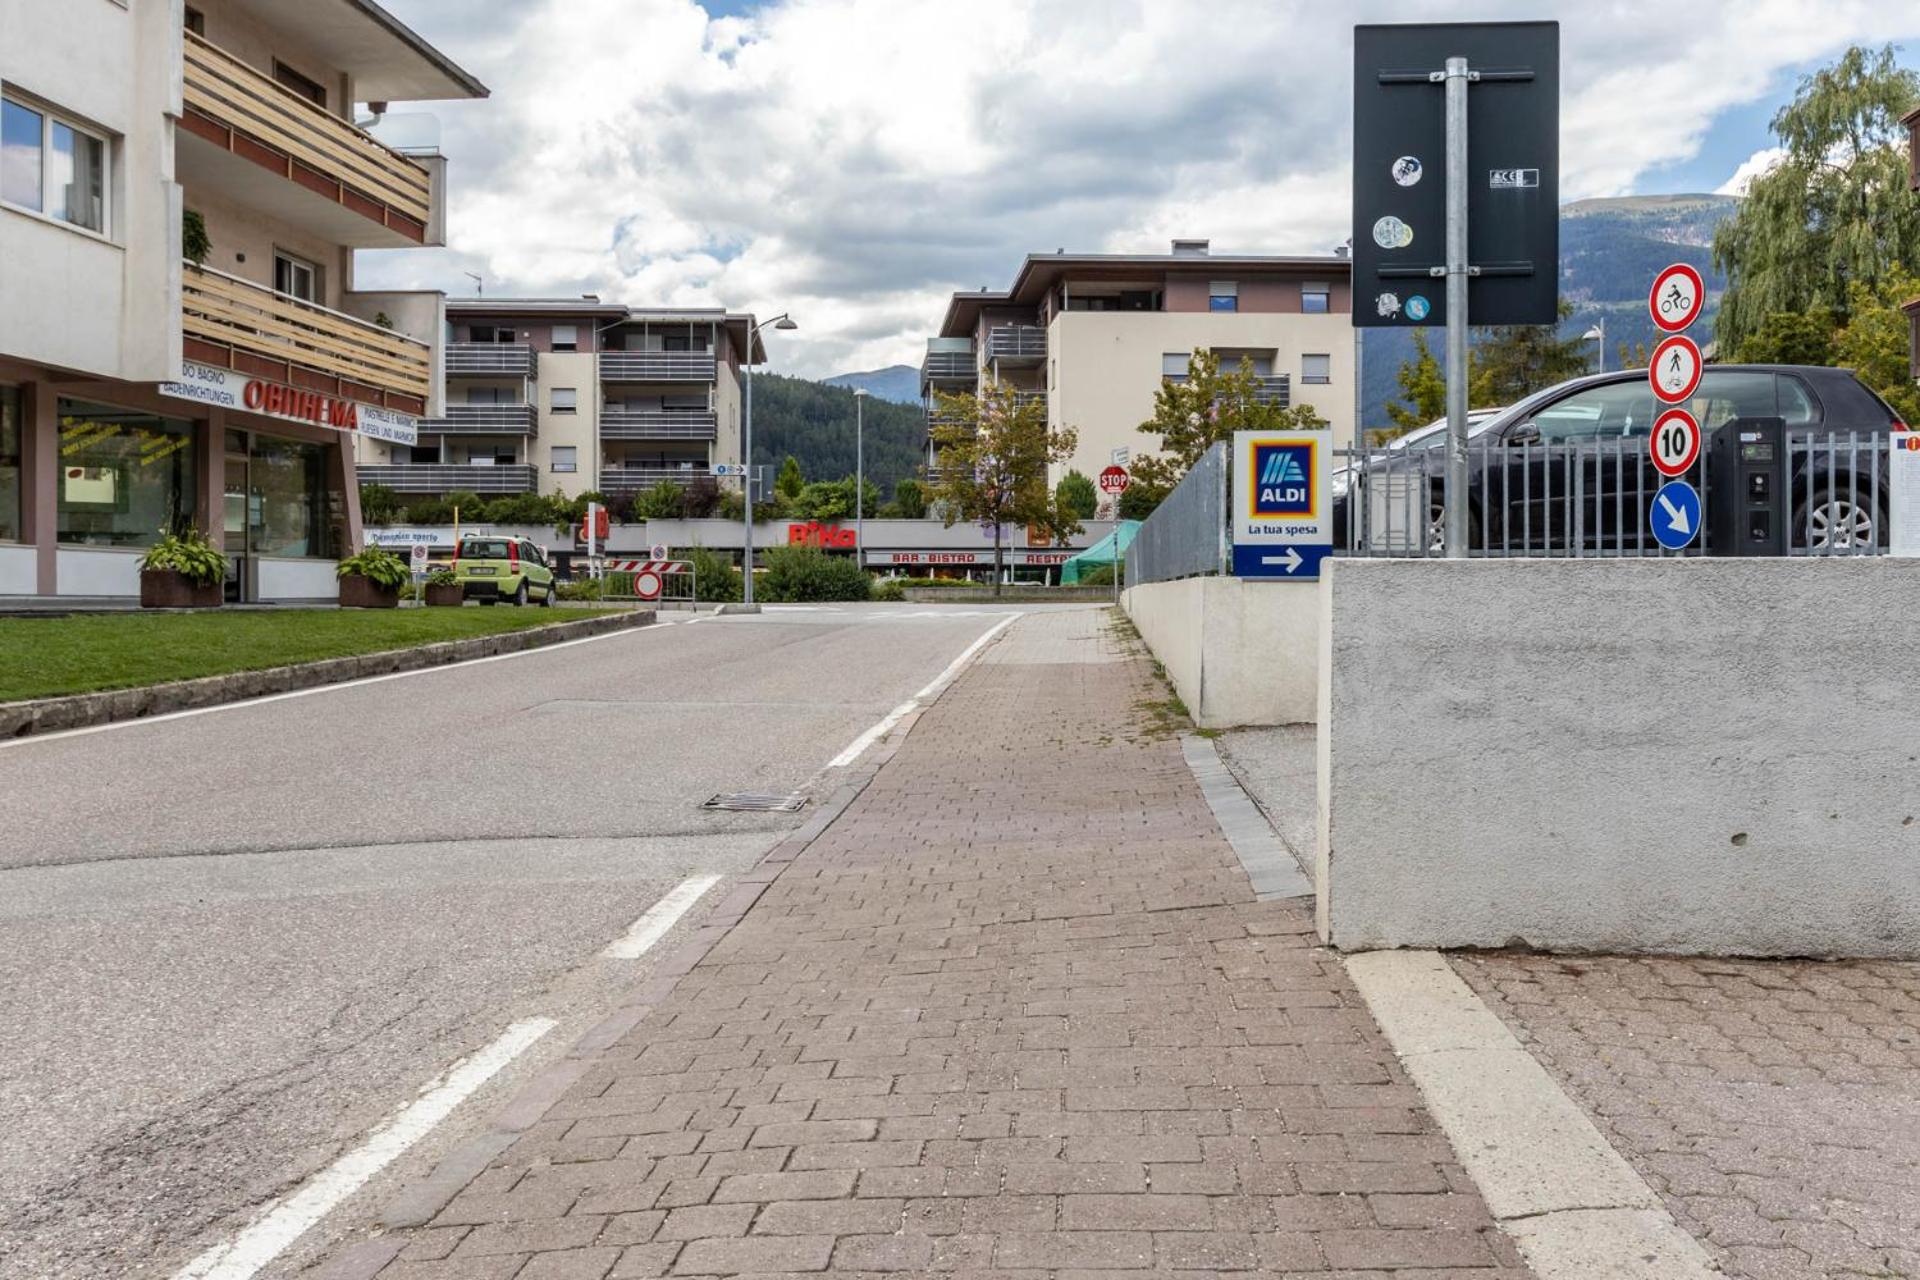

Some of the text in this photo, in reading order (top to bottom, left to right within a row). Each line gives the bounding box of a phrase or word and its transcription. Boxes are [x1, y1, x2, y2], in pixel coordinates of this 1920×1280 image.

[198, 367, 225, 385] BAGNO
[164, 383, 234, 405] BADEINRICHTUNGEN
[1662, 427, 1686, 457] 10
[1101, 474, 1126, 486] STOP
[1260, 488, 1306, 502] ALDI
[1248, 525, 1318, 536] La tua spesa
[892, 553, 975, 563] BAR BISTRO
